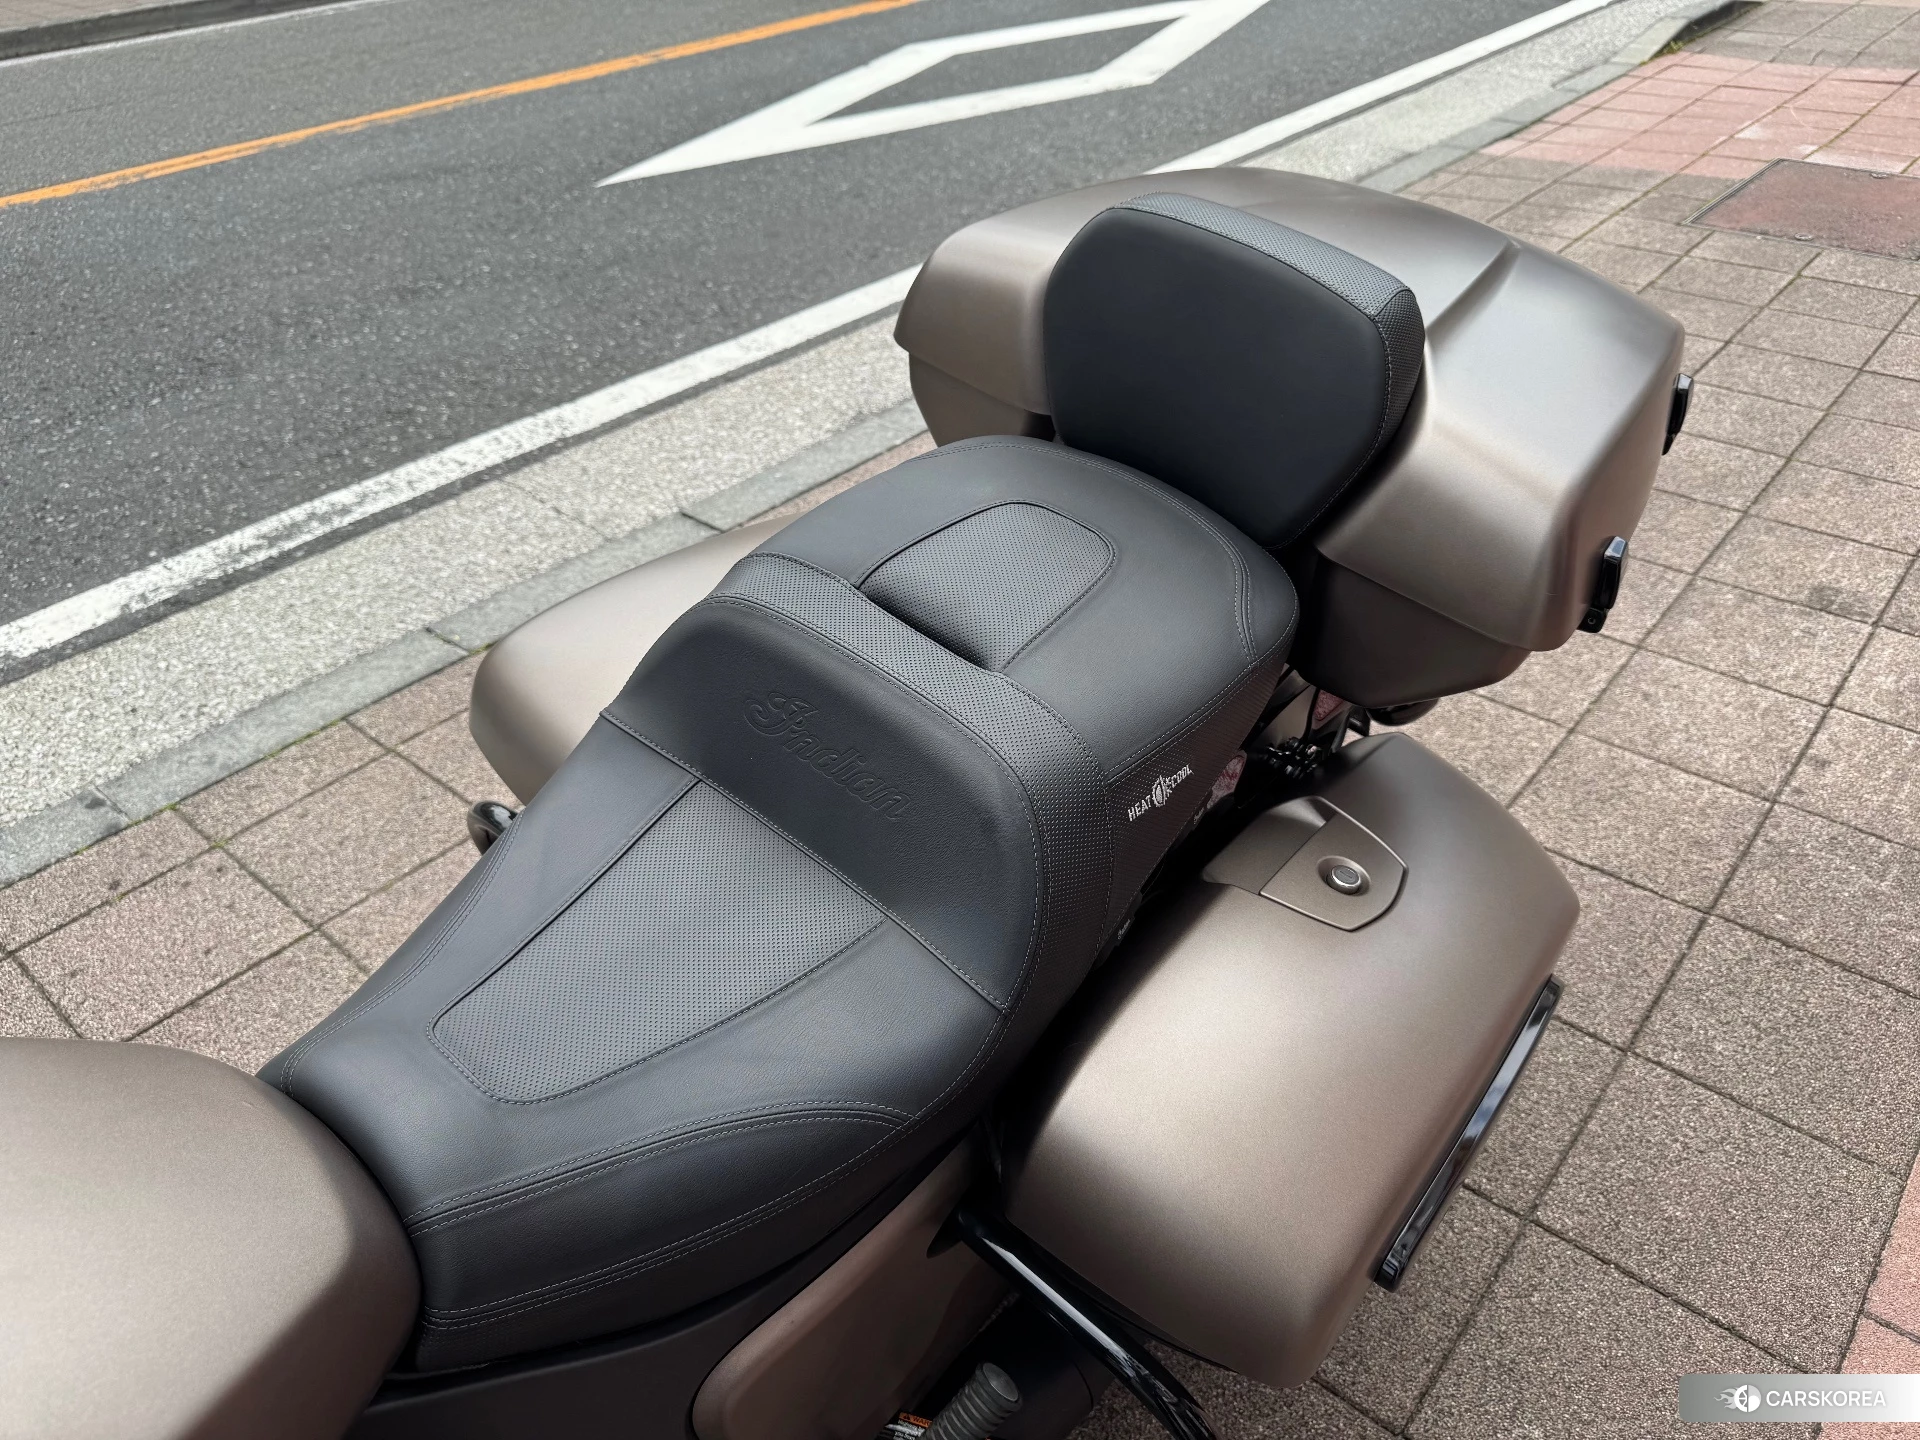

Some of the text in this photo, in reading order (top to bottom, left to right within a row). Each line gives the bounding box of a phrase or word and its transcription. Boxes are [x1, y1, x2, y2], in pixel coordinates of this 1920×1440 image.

[744, 692, 911, 819] Indian
[1127, 764, 1194, 822] HEAT COOL
